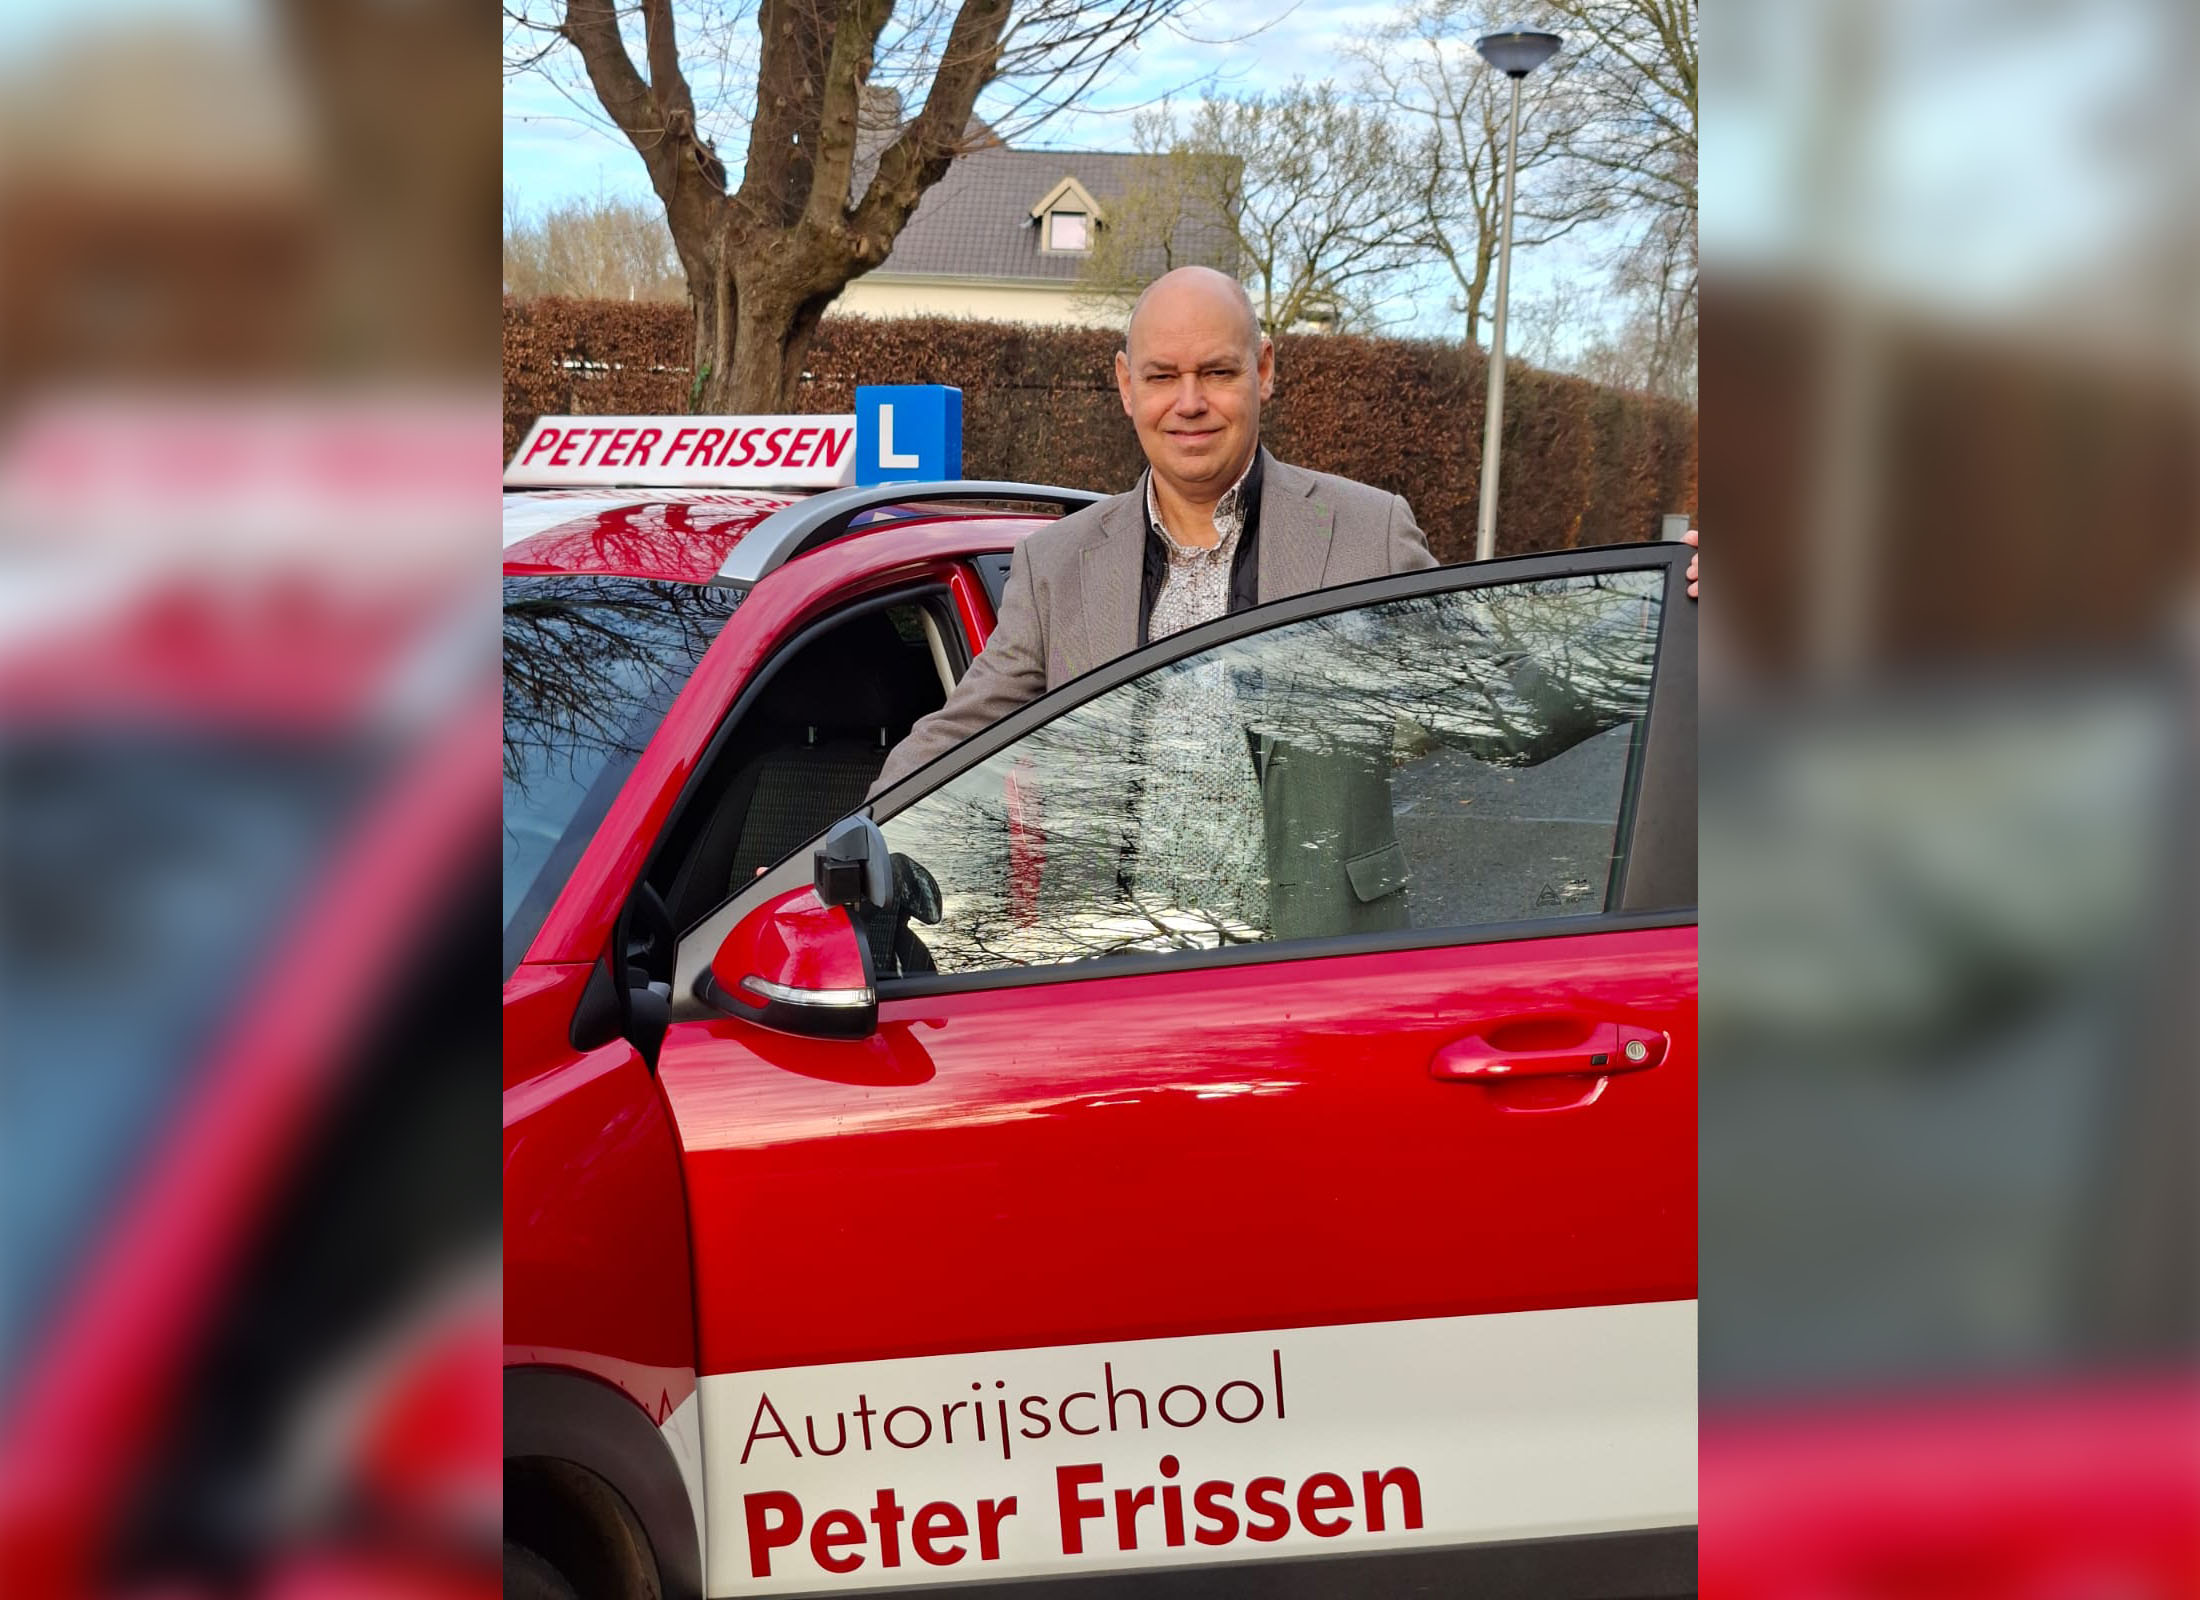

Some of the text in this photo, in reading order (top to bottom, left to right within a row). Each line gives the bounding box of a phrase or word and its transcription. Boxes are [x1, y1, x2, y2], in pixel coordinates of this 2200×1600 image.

[521, 428, 854, 468] PETER FRISSEN
[878, 403, 920, 469] L
[740, 1349, 1287, 1464] Autorijschool
[743, 1454, 1424, 1578] Peter Frissen
